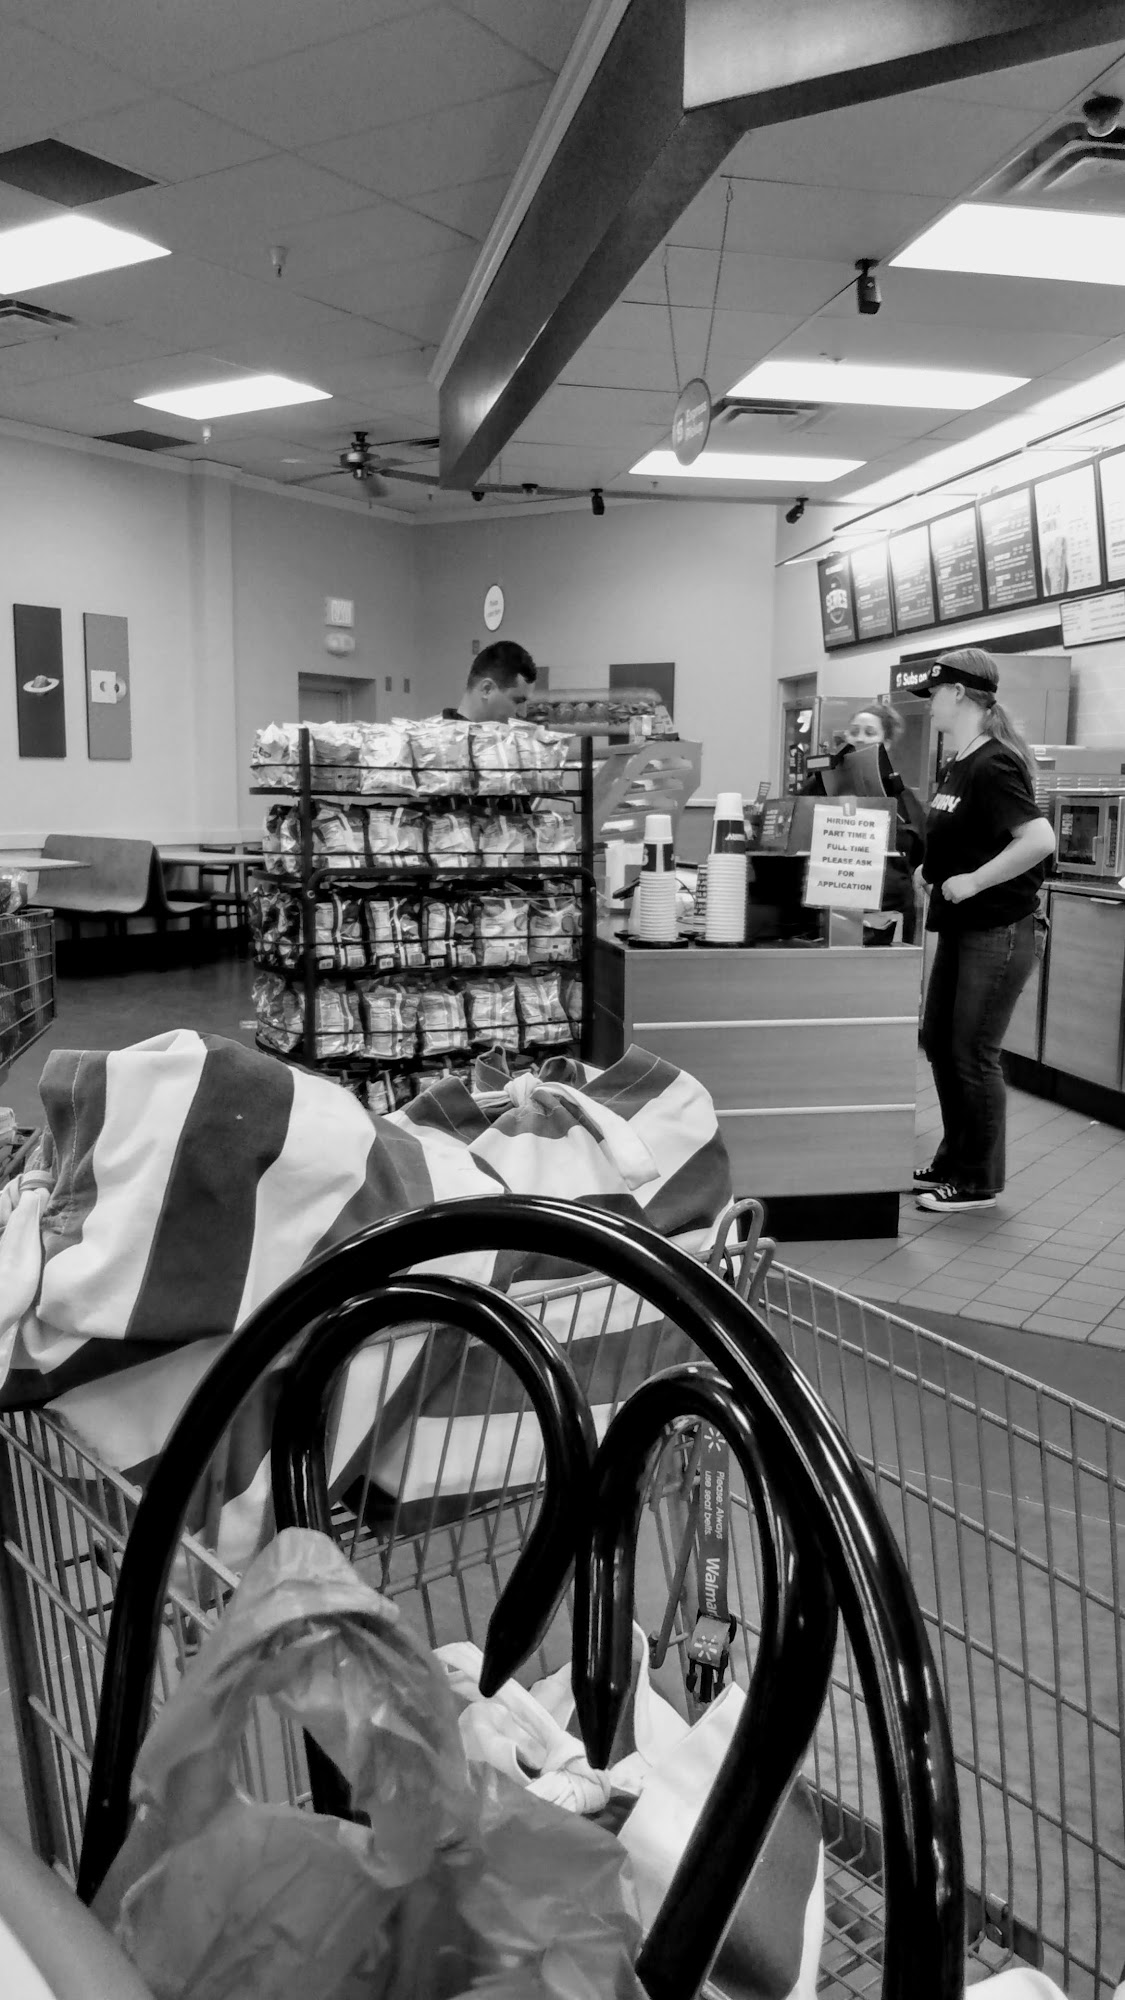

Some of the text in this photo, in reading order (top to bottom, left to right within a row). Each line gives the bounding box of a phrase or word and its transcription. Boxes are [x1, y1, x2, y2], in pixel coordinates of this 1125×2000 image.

[902, 671, 918, 686] Subs
[826, 817, 875, 828] HIRING FOR
[823, 829, 845, 837] PART
[847, 831, 867, 839] TIME
[827, 843, 870, 853] FULL TIME
[822, 856, 873, 867] PLEASE ASK
[838, 869, 854, 877] FOR
[817, 881, 872, 891] APPLICATION
[704, 1470, 712, 1488] use
[704, 1489, 712, 1511] seat
[715, 1506, 725, 1540] Always
